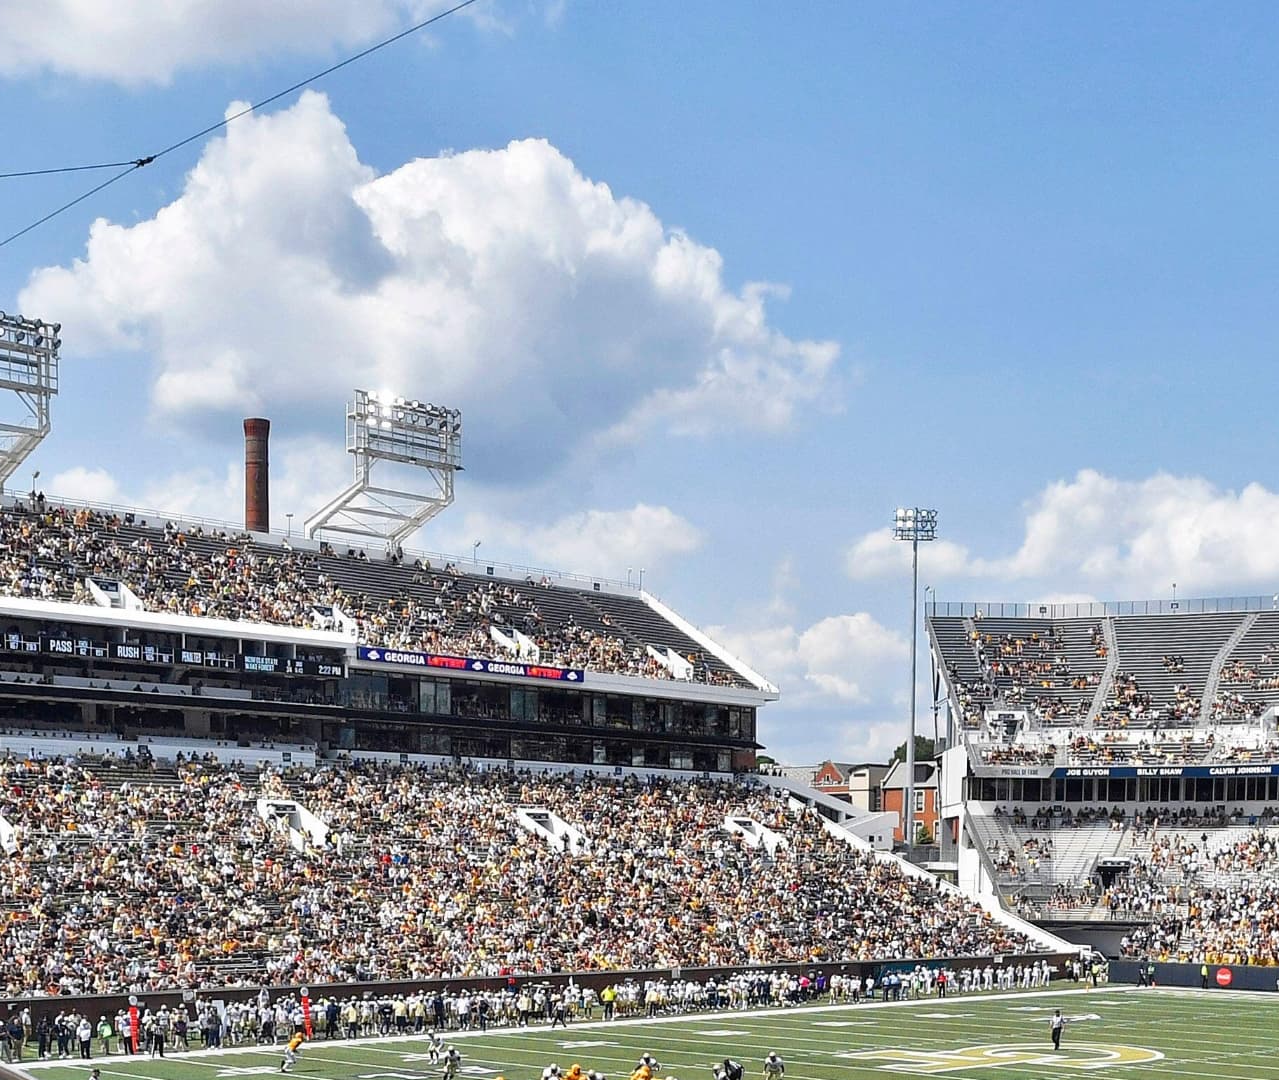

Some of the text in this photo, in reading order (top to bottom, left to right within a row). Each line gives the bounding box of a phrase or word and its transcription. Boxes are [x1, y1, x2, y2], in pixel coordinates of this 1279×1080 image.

[49, 639, 73, 653] PASS
[117, 645, 140, 659] RUSH
[384, 652, 467, 669] GEORGIA LOTTERY
[488, 662, 563, 679] GEORGIA LOTTERY
[1137, 768, 1183, 776] BILLY SHAW
[1209, 767, 1271, 775] CALVIN JOHNSON
